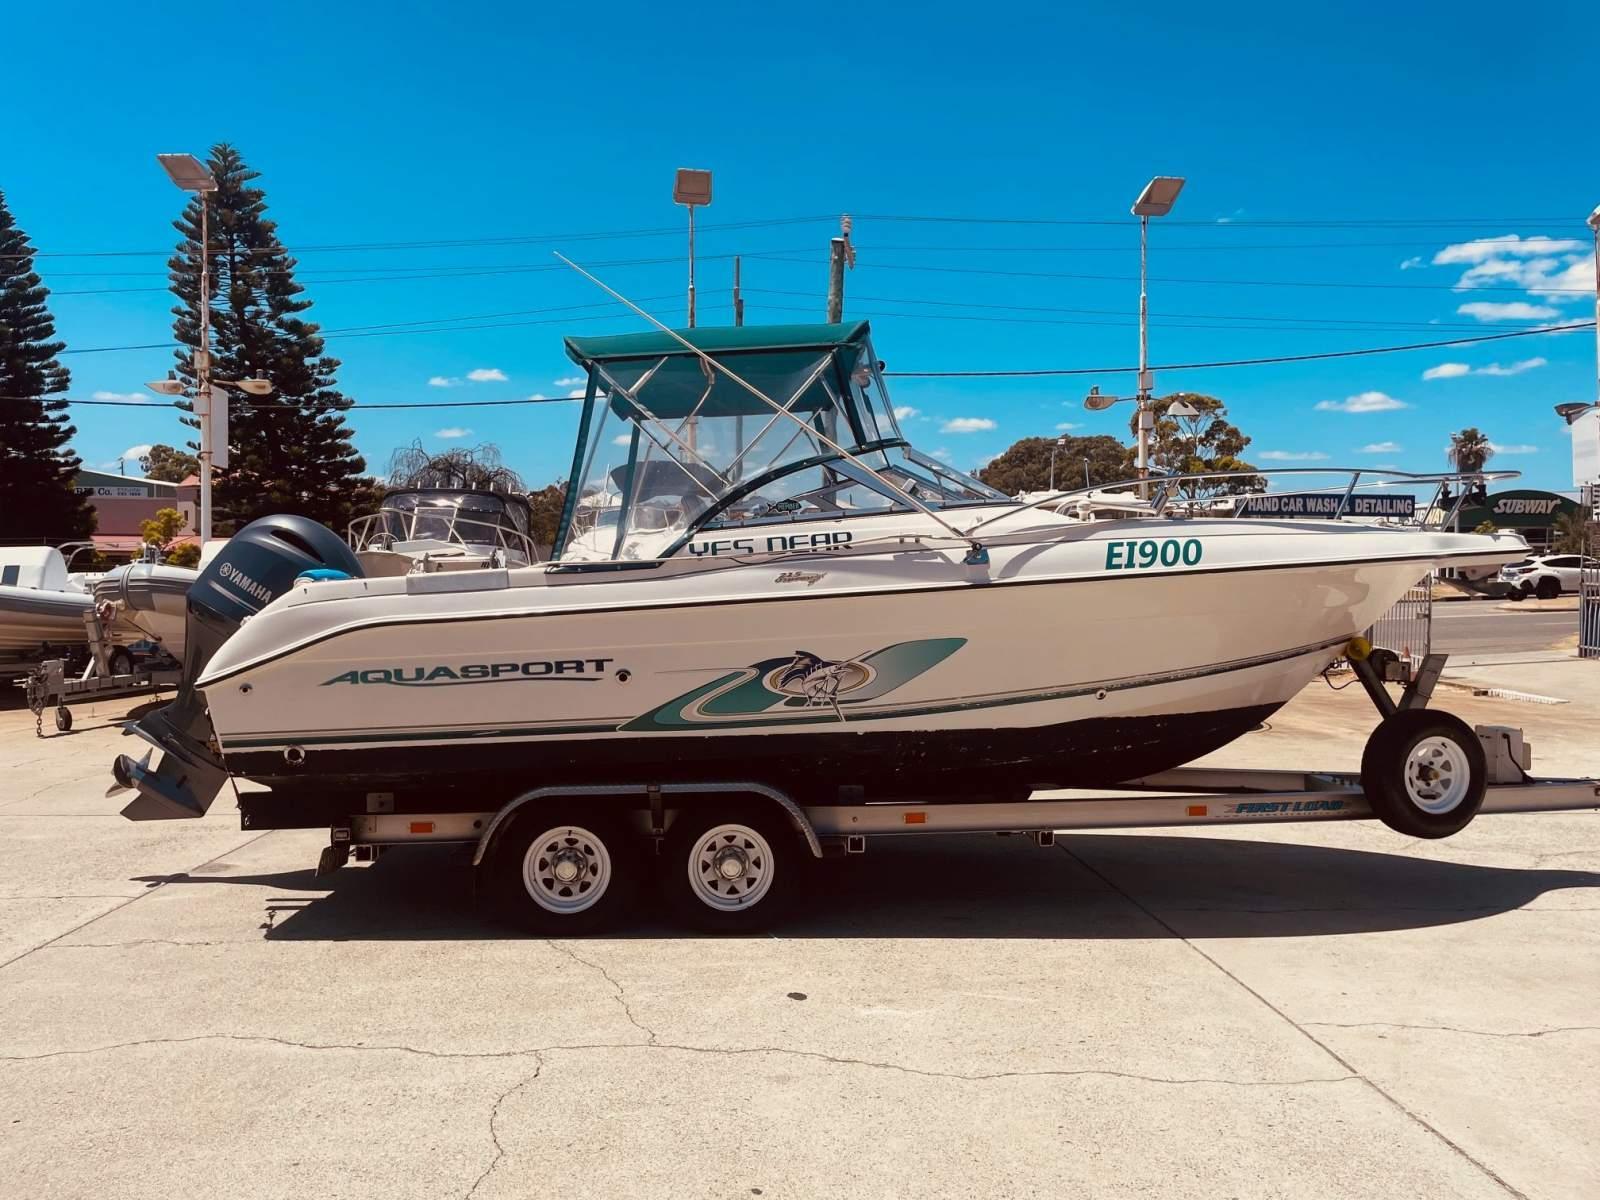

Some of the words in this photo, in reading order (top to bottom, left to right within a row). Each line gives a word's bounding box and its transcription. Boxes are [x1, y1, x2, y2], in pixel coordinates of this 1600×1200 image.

[1248, 497, 1279, 512] HAND
[1281, 498, 1304, 512] CAR
[1306, 498, 1338, 512] WASH
[1355, 499, 1413, 514] DETAILING
[1493, 499, 1561, 514] SUBWAY
[1105, 538, 1203, 570] EI900
[229, 567, 272, 604] YAMAHA
[318, 659, 613, 687] AQUASPORT
[1235, 801, 1293, 813] FIRST
